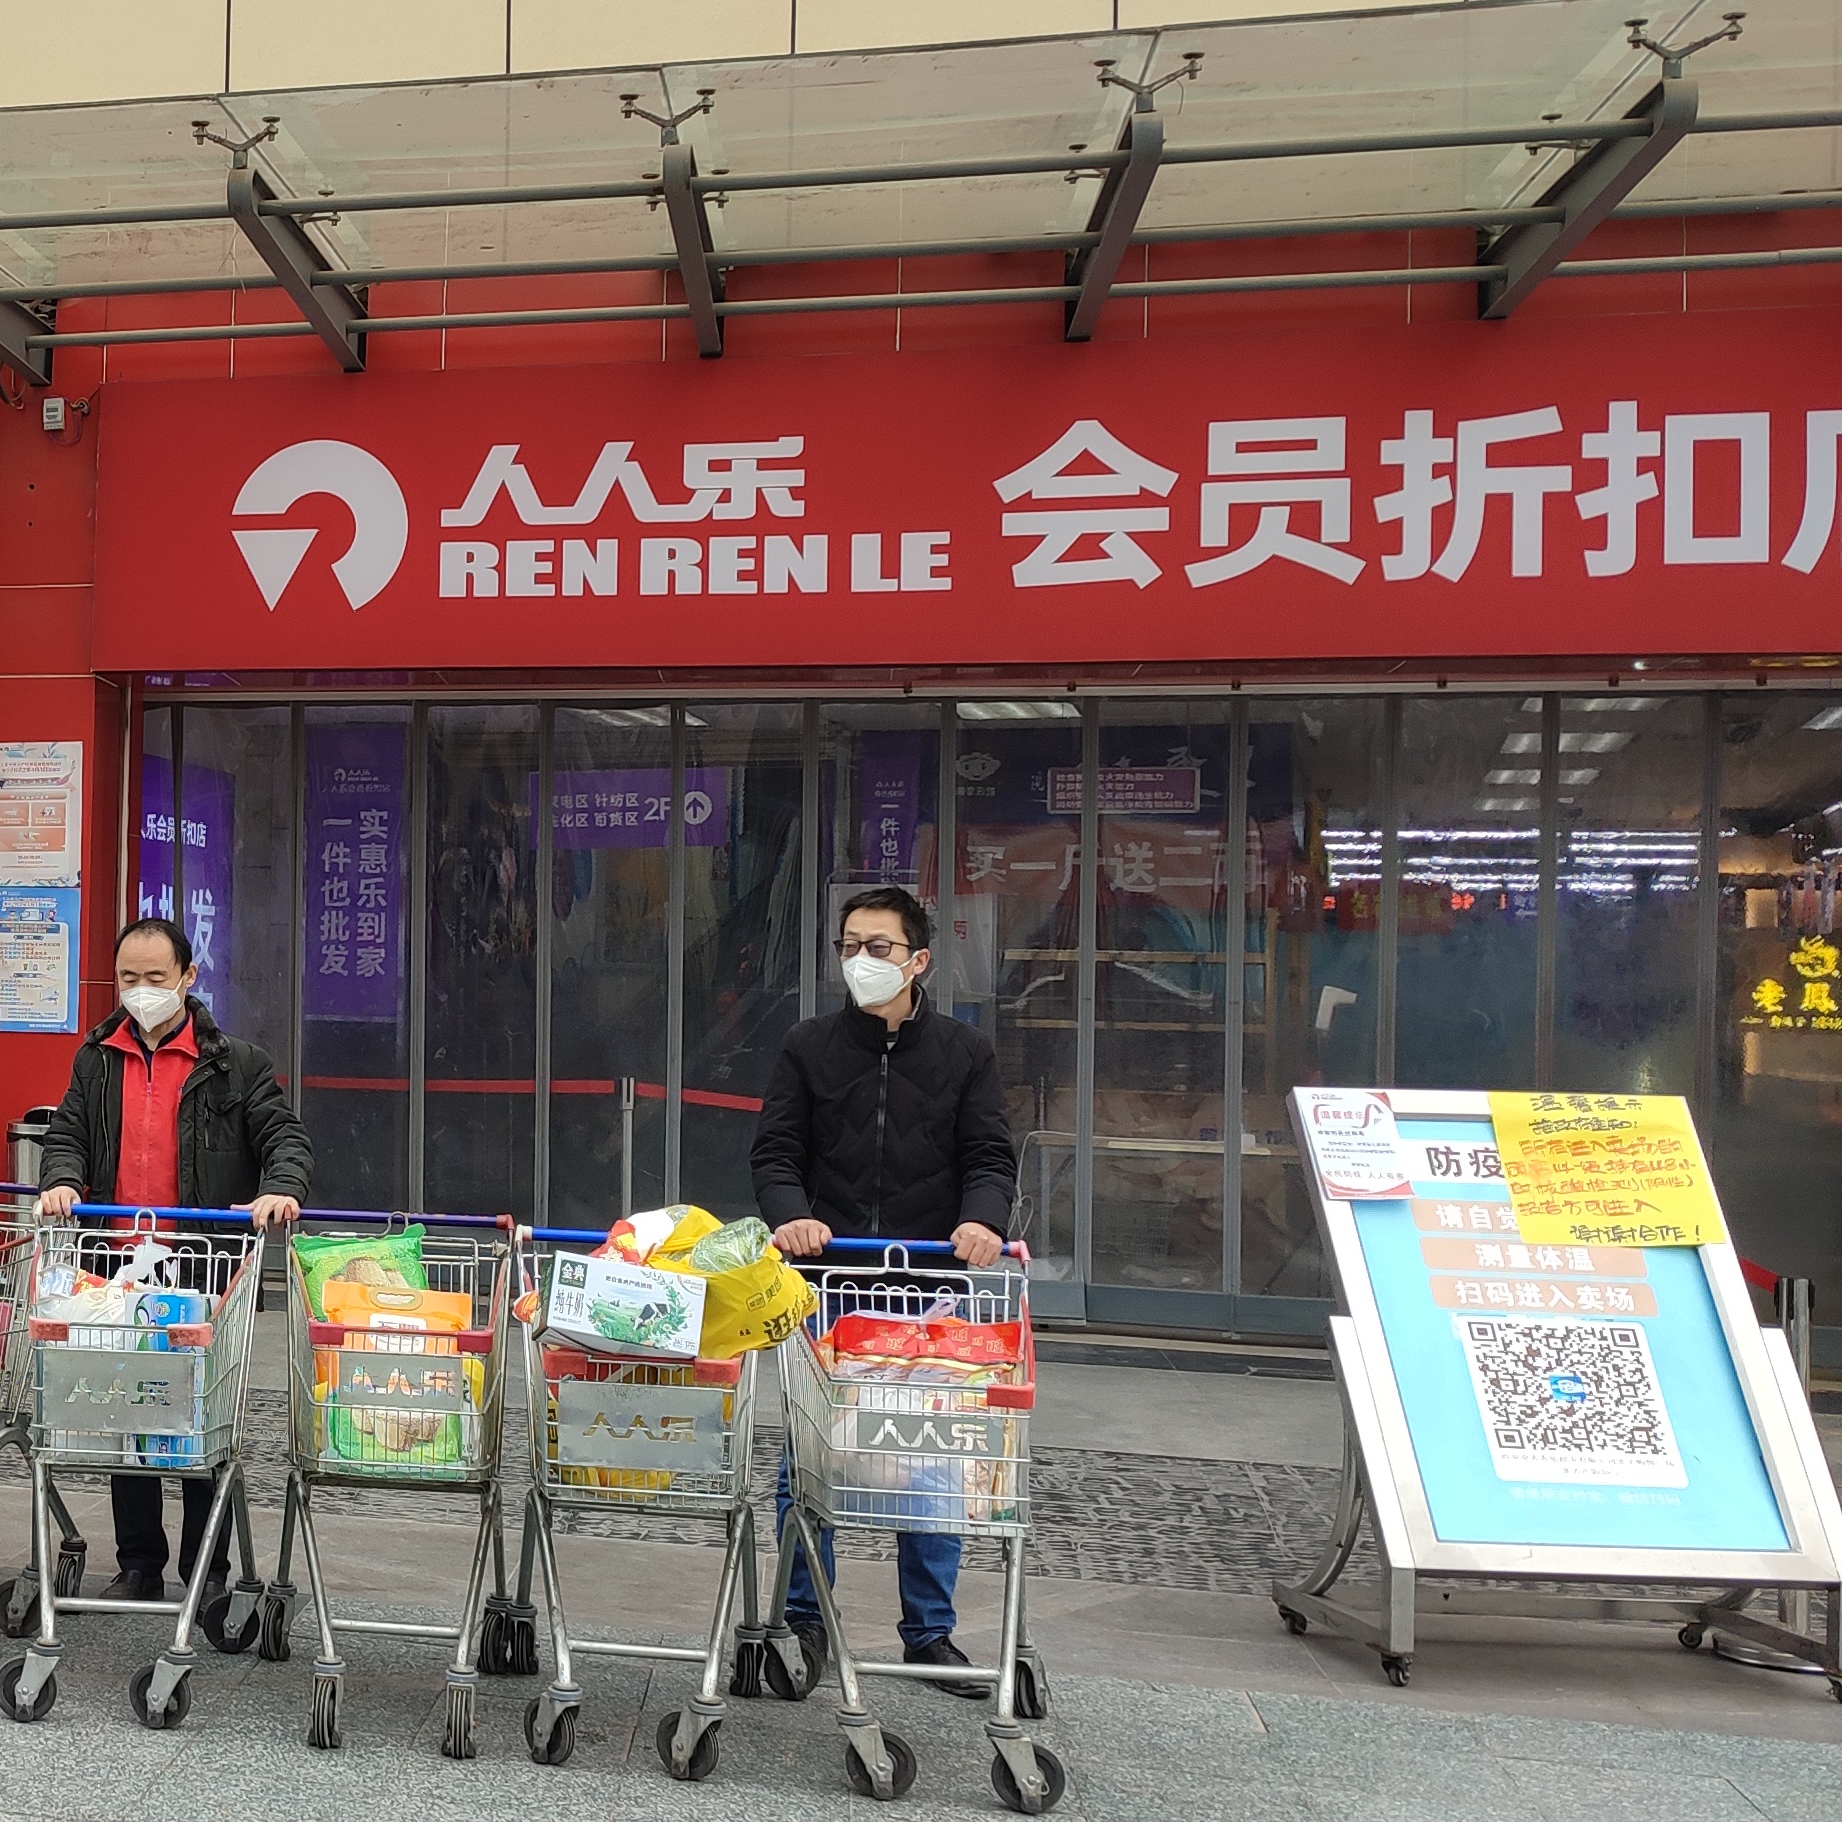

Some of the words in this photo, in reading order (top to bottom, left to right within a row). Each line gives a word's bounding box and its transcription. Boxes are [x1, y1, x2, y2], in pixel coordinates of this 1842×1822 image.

[440, 435, 806, 527] 人人乐
[439, 538, 619, 599] REN
[639, 533, 829, 597] REN
[850, 531, 953, 593] LE
[594, 792, 640, 808] 针纺区
[643, 796, 672, 822] 2F
[594, 812, 639, 828] 百货区
[140, 813, 208, 849] 乐会员扣店
[319, 817, 353, 977] 一件也批发
[356, 808, 390, 978] 实惠乐到家
[1425, 1146, 1506, 1178] 防疫
[1435, 1203, 1521, 1231] 请自觉
[561, 1262, 585, 1283] 金典
[1475, 1243, 1596, 1272] 测量体温
[554, 1288, 585, 1318] 纯牛奶
[1454, 1279, 1635, 1312] 扫码进入卖场
[64, 1376, 173, 1408] 人人乐
[342, 1365, 458, 1399] 人人乐
[581, 1410, 698, 1444] 人人乐
[867, 1417, 992, 1453] 人人乐
